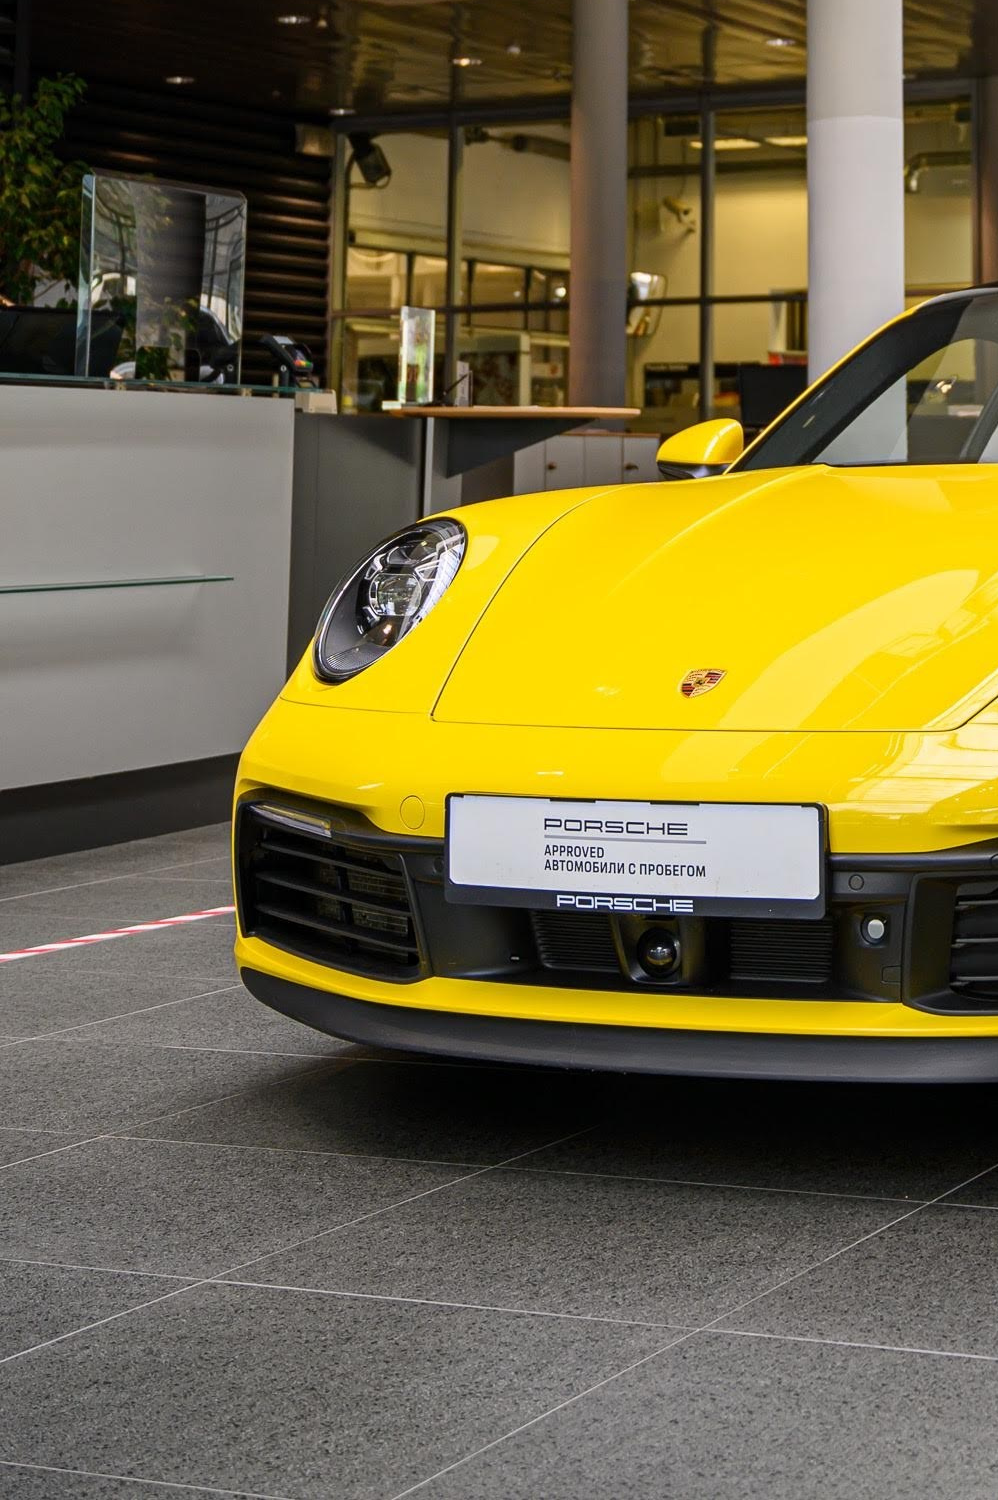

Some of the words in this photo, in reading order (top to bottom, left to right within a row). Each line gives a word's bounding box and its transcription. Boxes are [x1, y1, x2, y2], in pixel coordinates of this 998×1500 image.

[544, 818, 688, 836] PORSCHE
[544, 844, 605, 859] APPROVED
[544, 858, 625, 875] АВТОМОБИЛИ
[628, 863, 637, 875] С
[639, 863, 706, 878] ПРОБЕГОМ
[556, 894, 694, 913] PORSCHE
